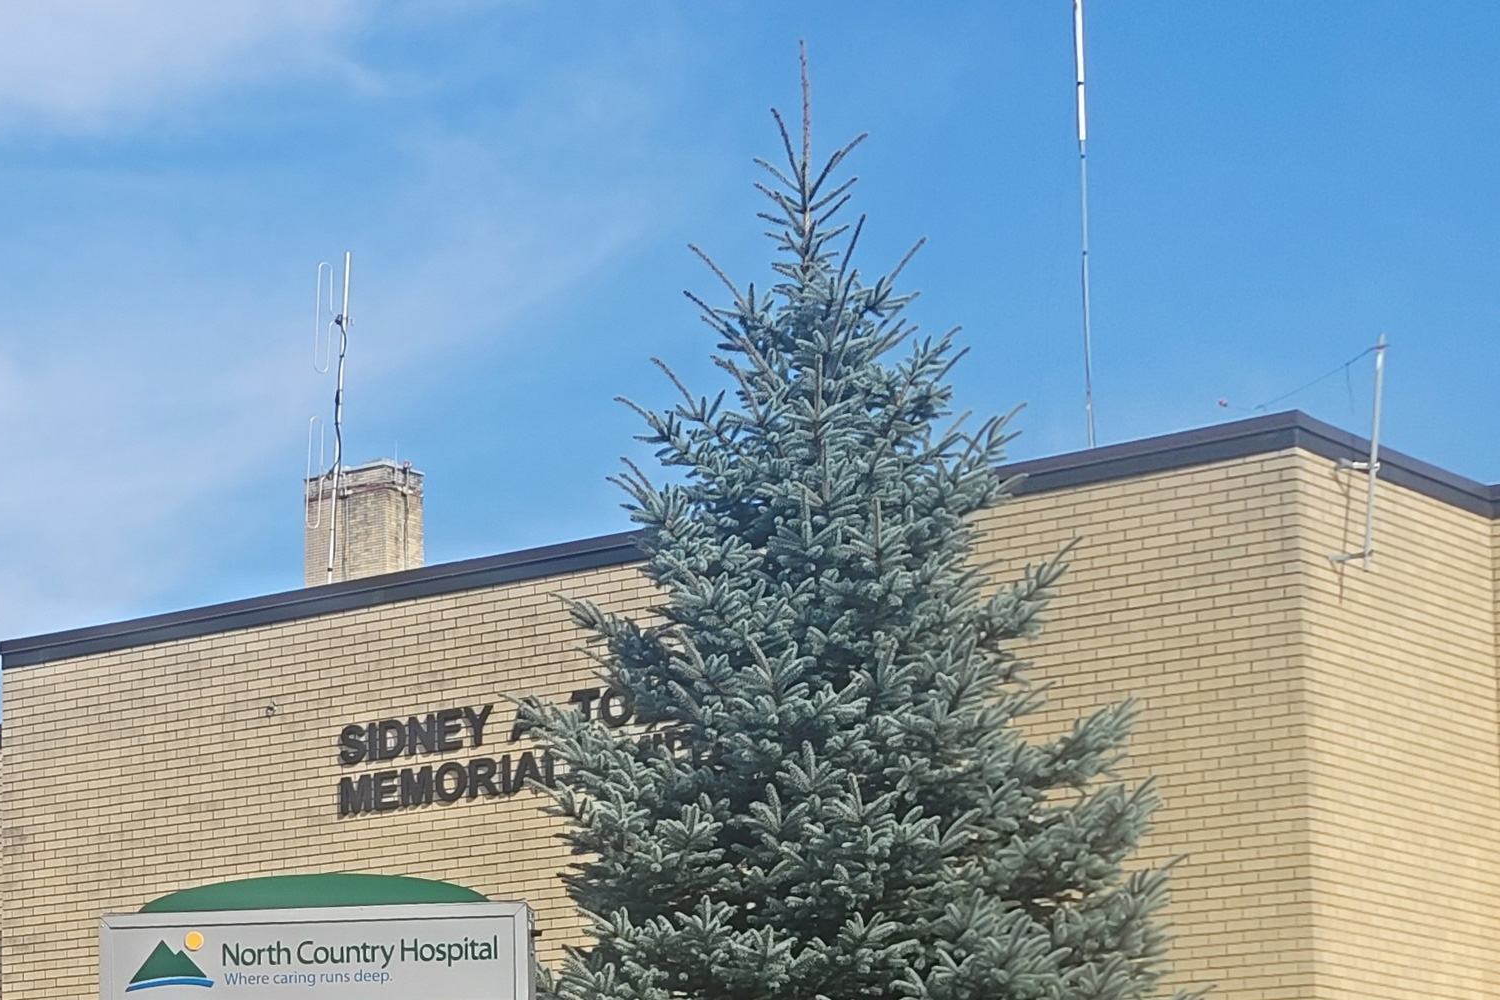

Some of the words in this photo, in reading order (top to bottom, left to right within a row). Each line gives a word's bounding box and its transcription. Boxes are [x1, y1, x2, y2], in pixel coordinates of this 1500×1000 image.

[340, 704, 494, 766] SIDNEY
[340, 749, 557, 817] MEMORIAL
[222, 940, 292, 967] North
[297, 939, 395, 969] Country
[400, 935, 498, 967] Hospital
[224, 971, 269, 986] Where
[273, 971, 316, 987] caring
[320, 971, 350, 983] runs
[354, 969, 393, 985] deep.
